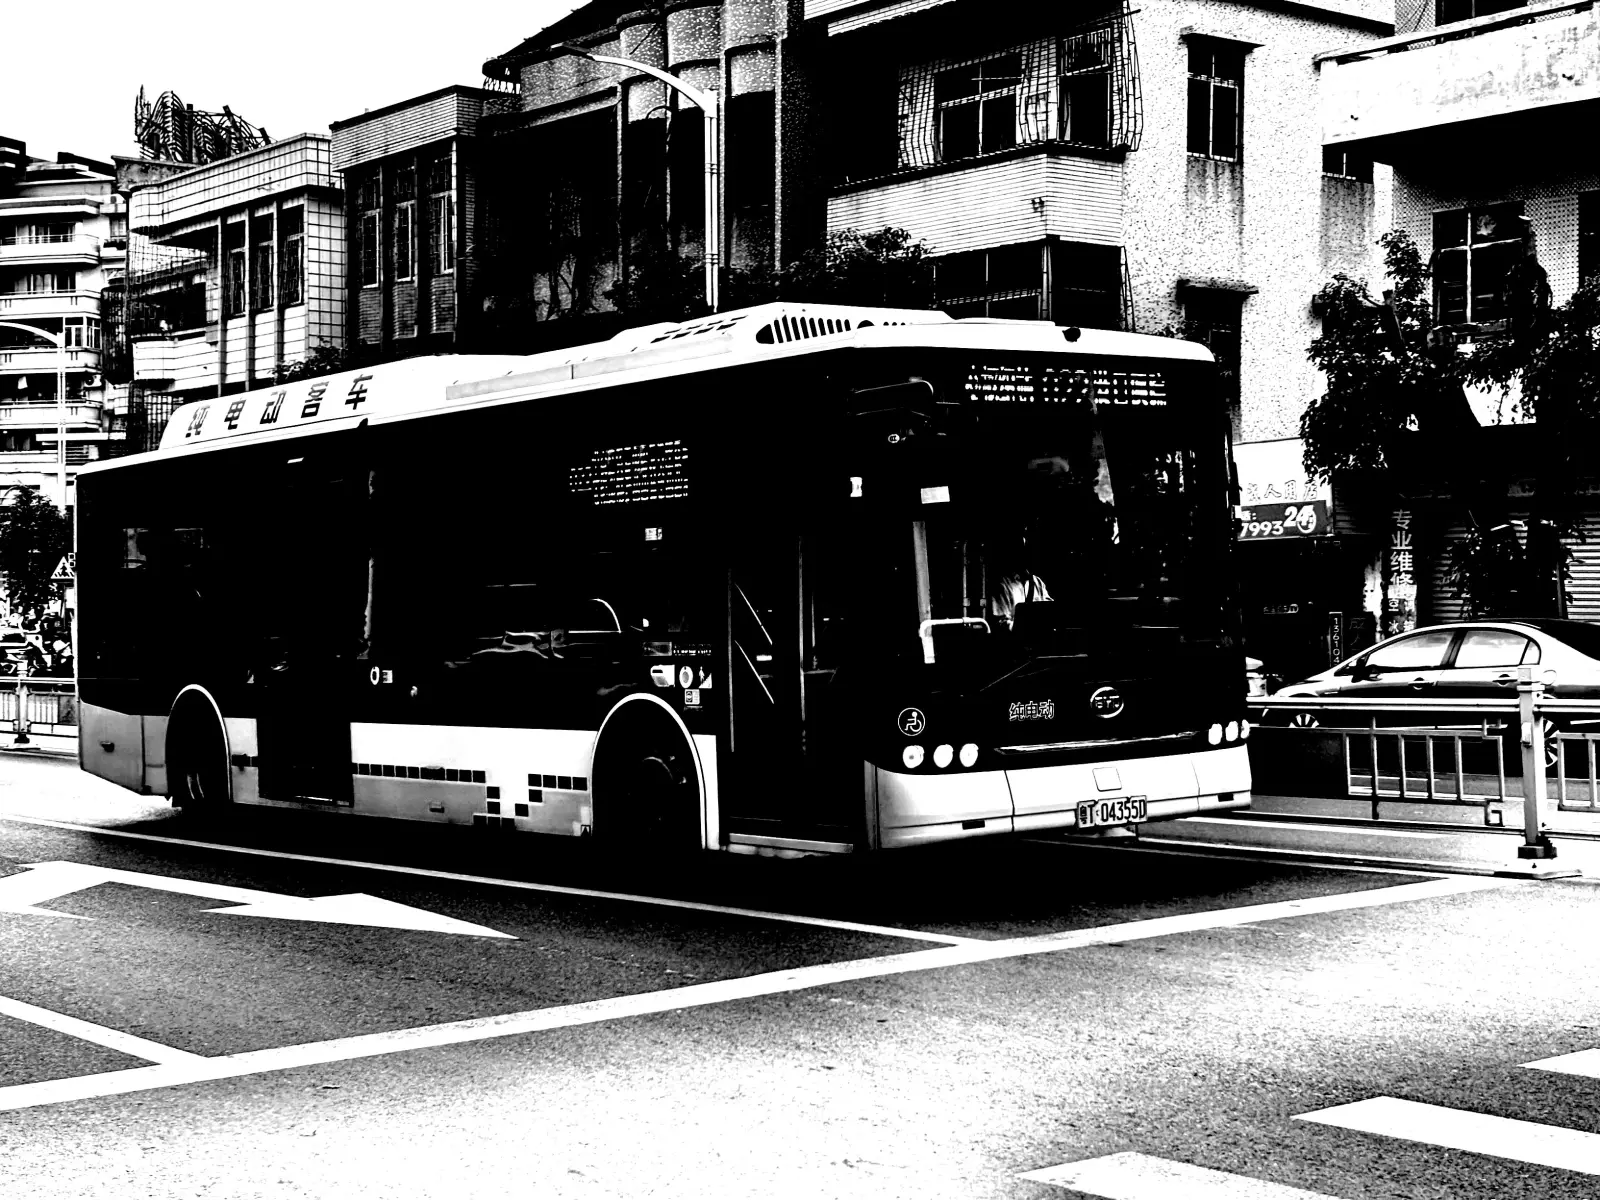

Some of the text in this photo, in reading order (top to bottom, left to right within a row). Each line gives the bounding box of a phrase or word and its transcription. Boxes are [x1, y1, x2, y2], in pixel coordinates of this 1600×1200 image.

[185, 374, 374, 438] 纯电动客车
[1390, 508, 1414, 586] 专业维修
[1332, 617, 1341, 664] 136104
[1009, 699, 1055, 721] 纯电动
